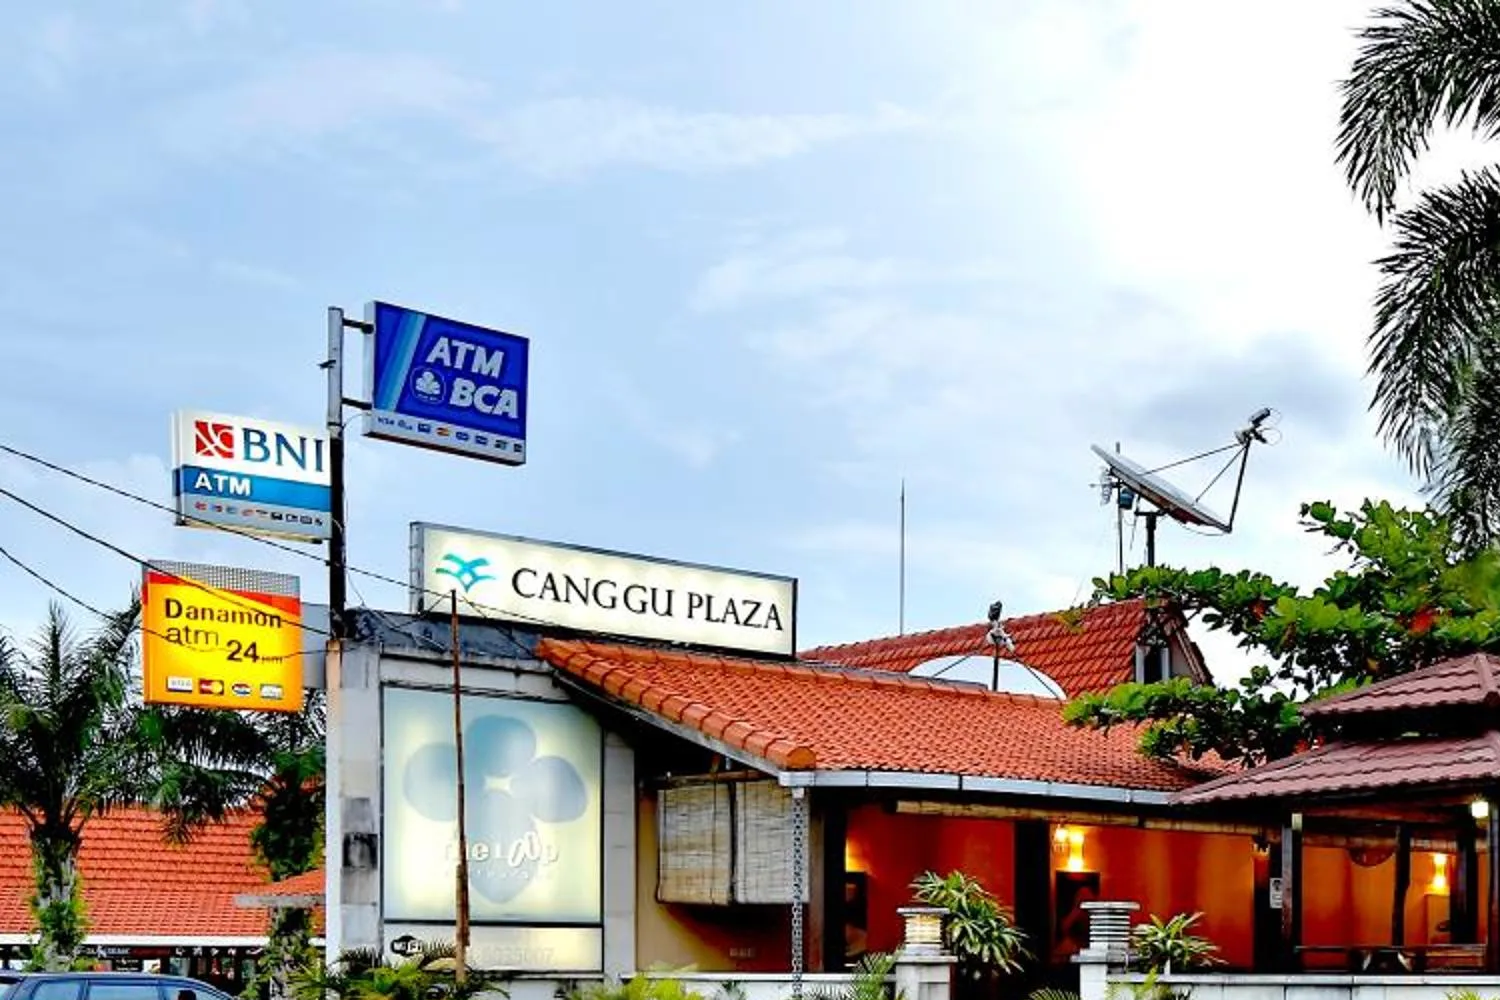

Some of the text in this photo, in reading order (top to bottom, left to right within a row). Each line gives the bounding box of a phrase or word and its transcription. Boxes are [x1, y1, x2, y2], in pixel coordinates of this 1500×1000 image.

[425, 336, 505, 379] ATM
[449, 377, 519, 419] BCA
[241, 427, 324, 473] BNI
[194, 472, 251, 498] ATM
[164, 597, 283, 629] Danamon
[511, 567, 785, 632] CANGGU PLAZA
[165, 624, 220, 647] atm
[225, 639, 261, 664] 24
